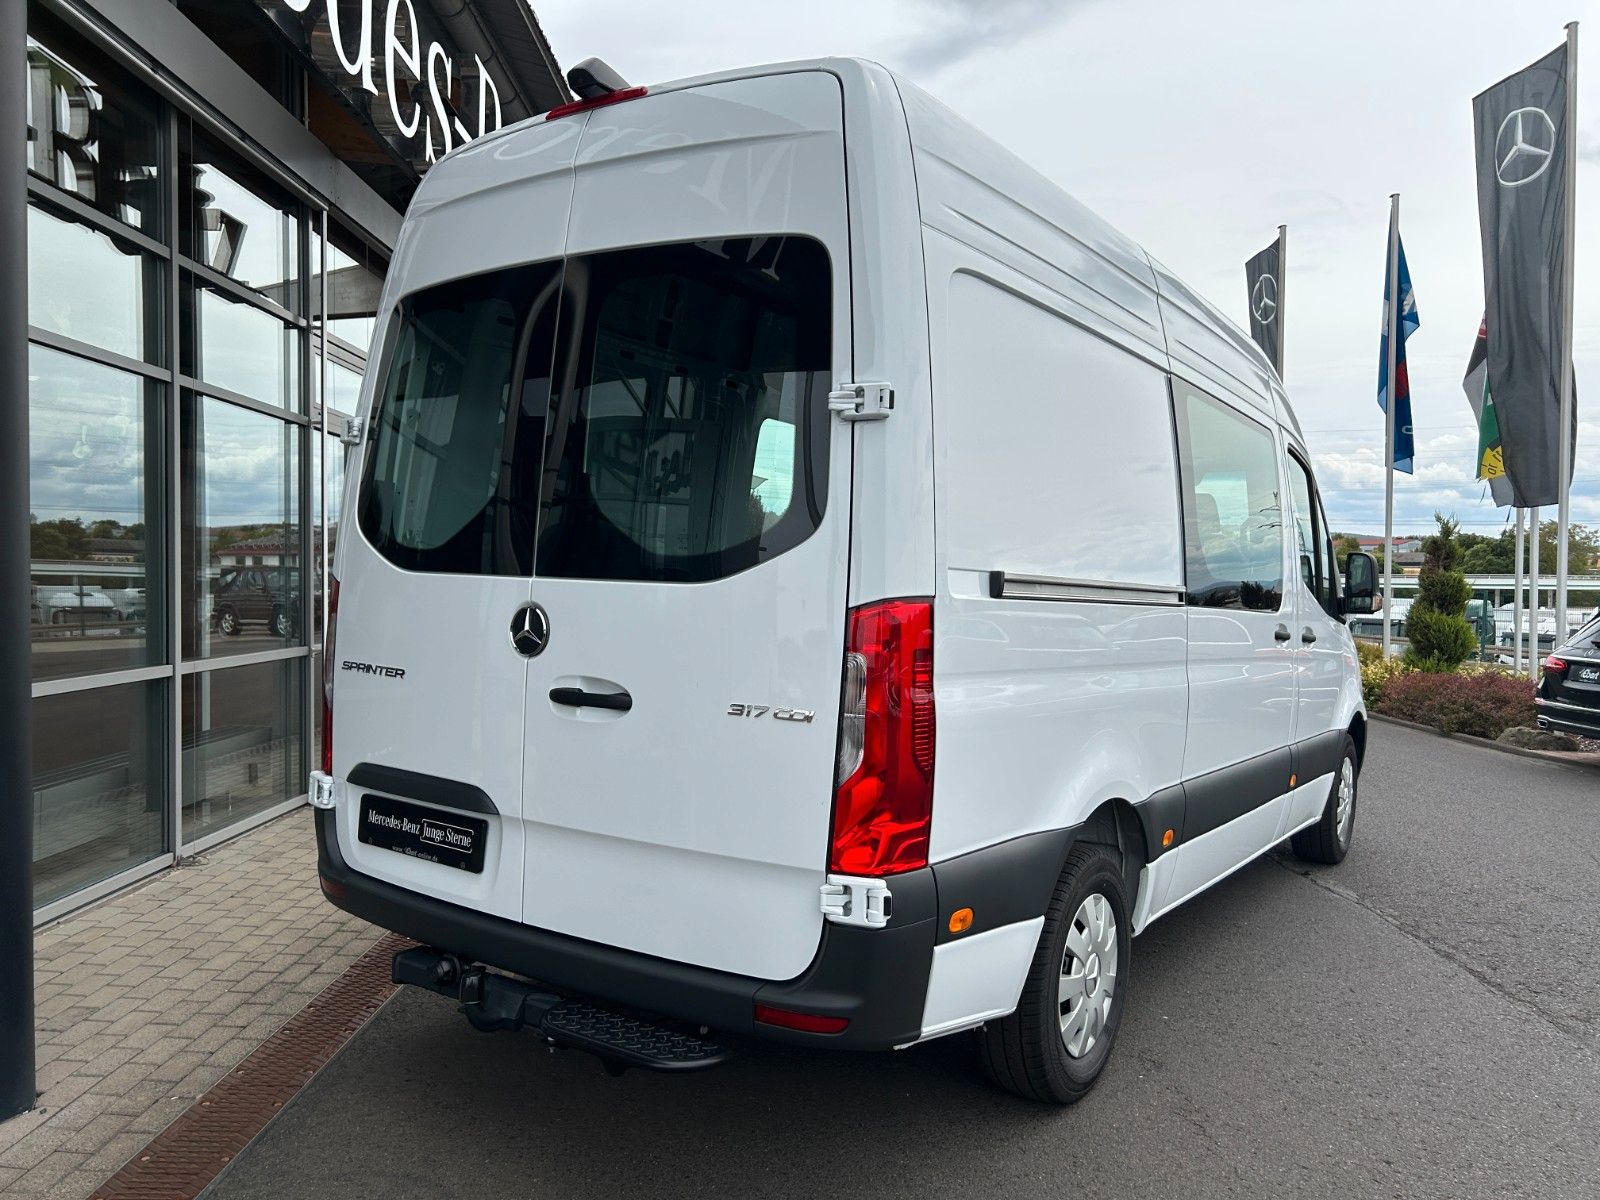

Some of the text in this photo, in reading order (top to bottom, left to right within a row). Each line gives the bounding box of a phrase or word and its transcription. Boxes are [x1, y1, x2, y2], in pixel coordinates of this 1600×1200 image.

[341, 660, 406, 679] SPRINTER
[727, 703, 816, 723] 317 CDI
[367, 809, 472, 848] Mercedes-Benz Junge Sterne
